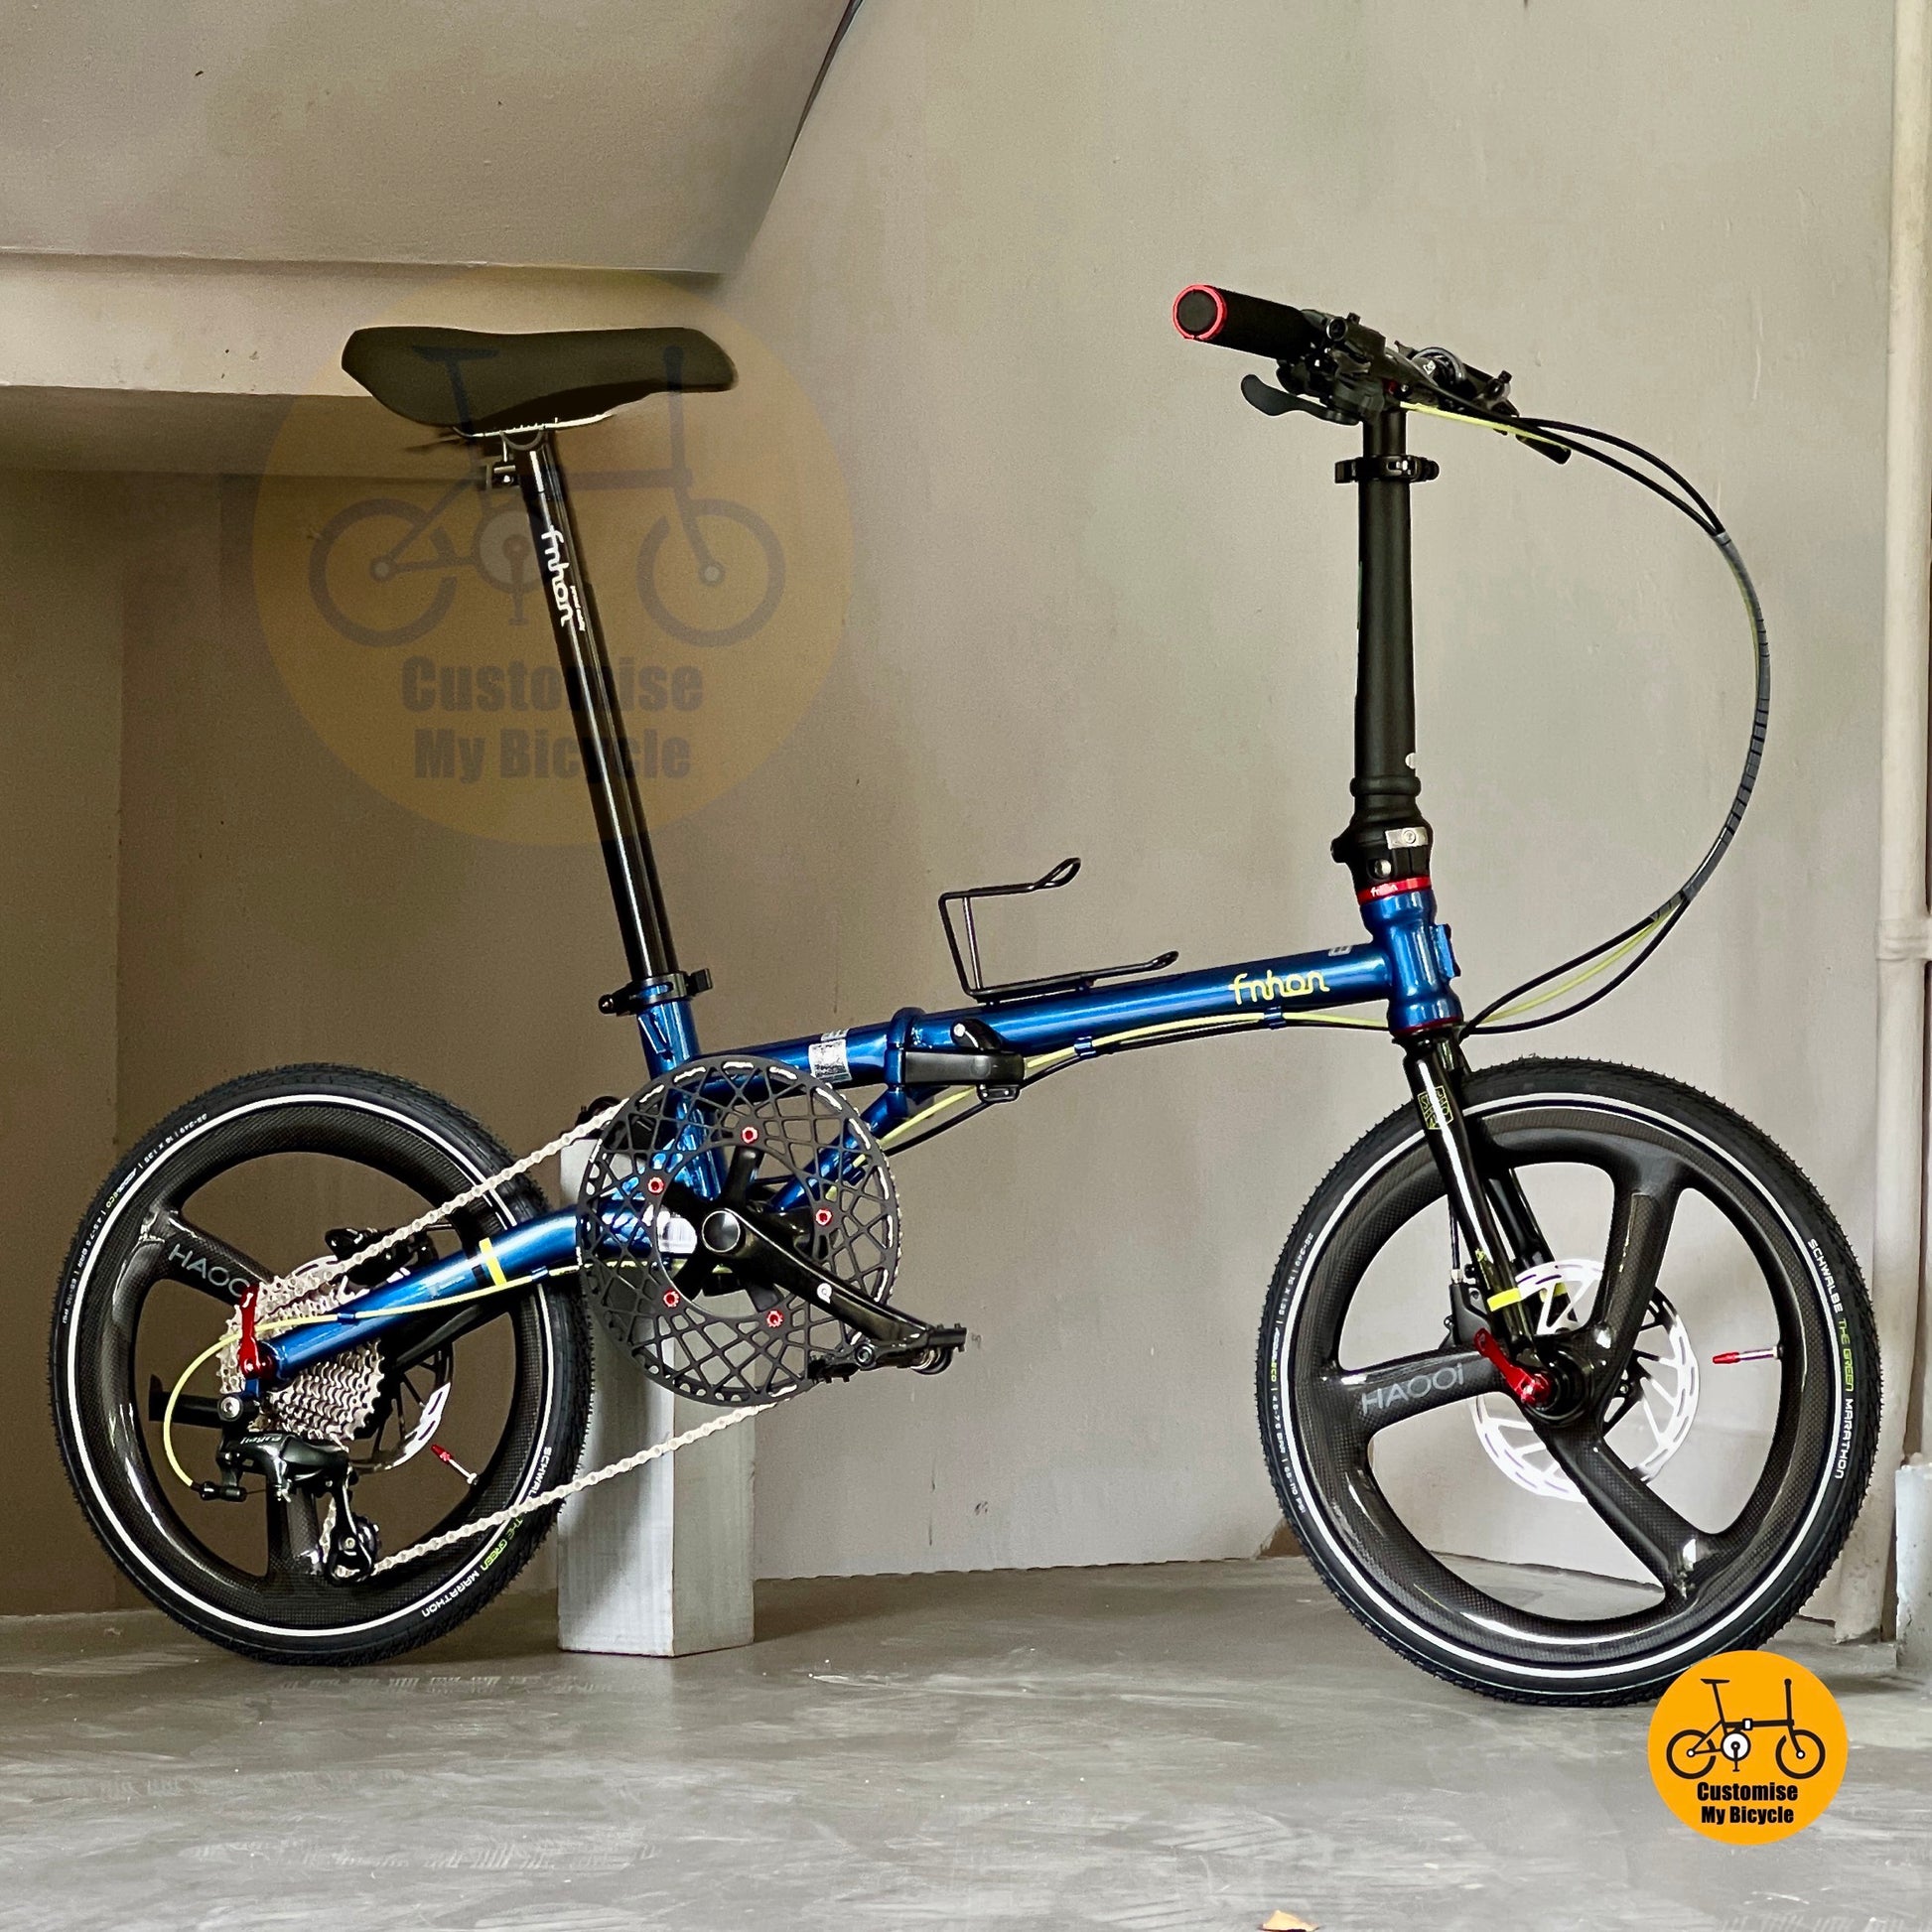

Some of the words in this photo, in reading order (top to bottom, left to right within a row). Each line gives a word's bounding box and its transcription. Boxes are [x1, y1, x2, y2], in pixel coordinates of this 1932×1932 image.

[540, 524, 574, 627] fnhon
[1227, 969, 1330, 1006] fnhon
[168, 1243, 250, 1298] HAOO
[1807, 1238, 1844, 1313] SCHWALBE
[1838, 1318, 1851, 1345] THE
[528, 1447, 553, 1497] SCHWAL
[505, 1517, 523, 1540] THE
